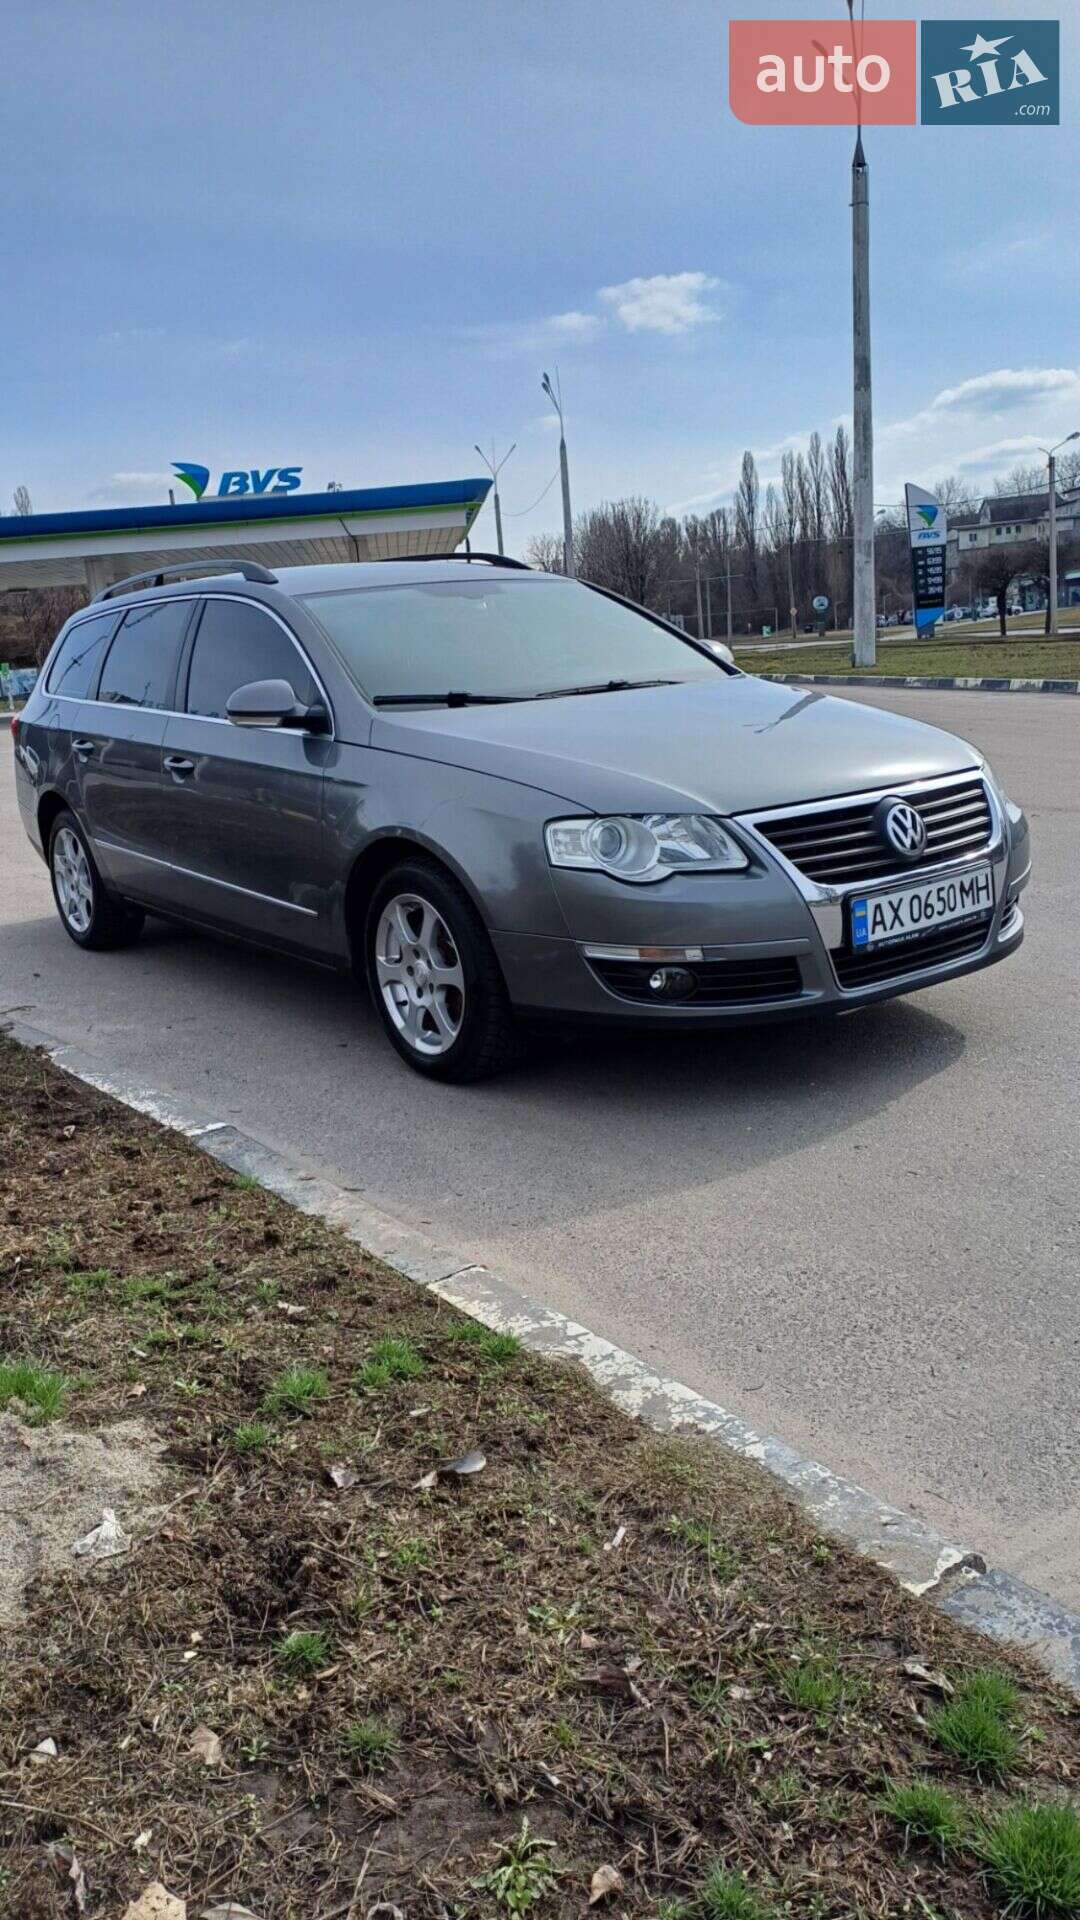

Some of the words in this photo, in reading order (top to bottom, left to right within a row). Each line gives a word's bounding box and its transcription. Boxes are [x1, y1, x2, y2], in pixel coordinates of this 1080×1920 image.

[218, 467, 303, 496] BVS
[871, 898, 905, 935] AX
[910, 883, 957, 923] 0650
[959, 872, 991, 909] MH
